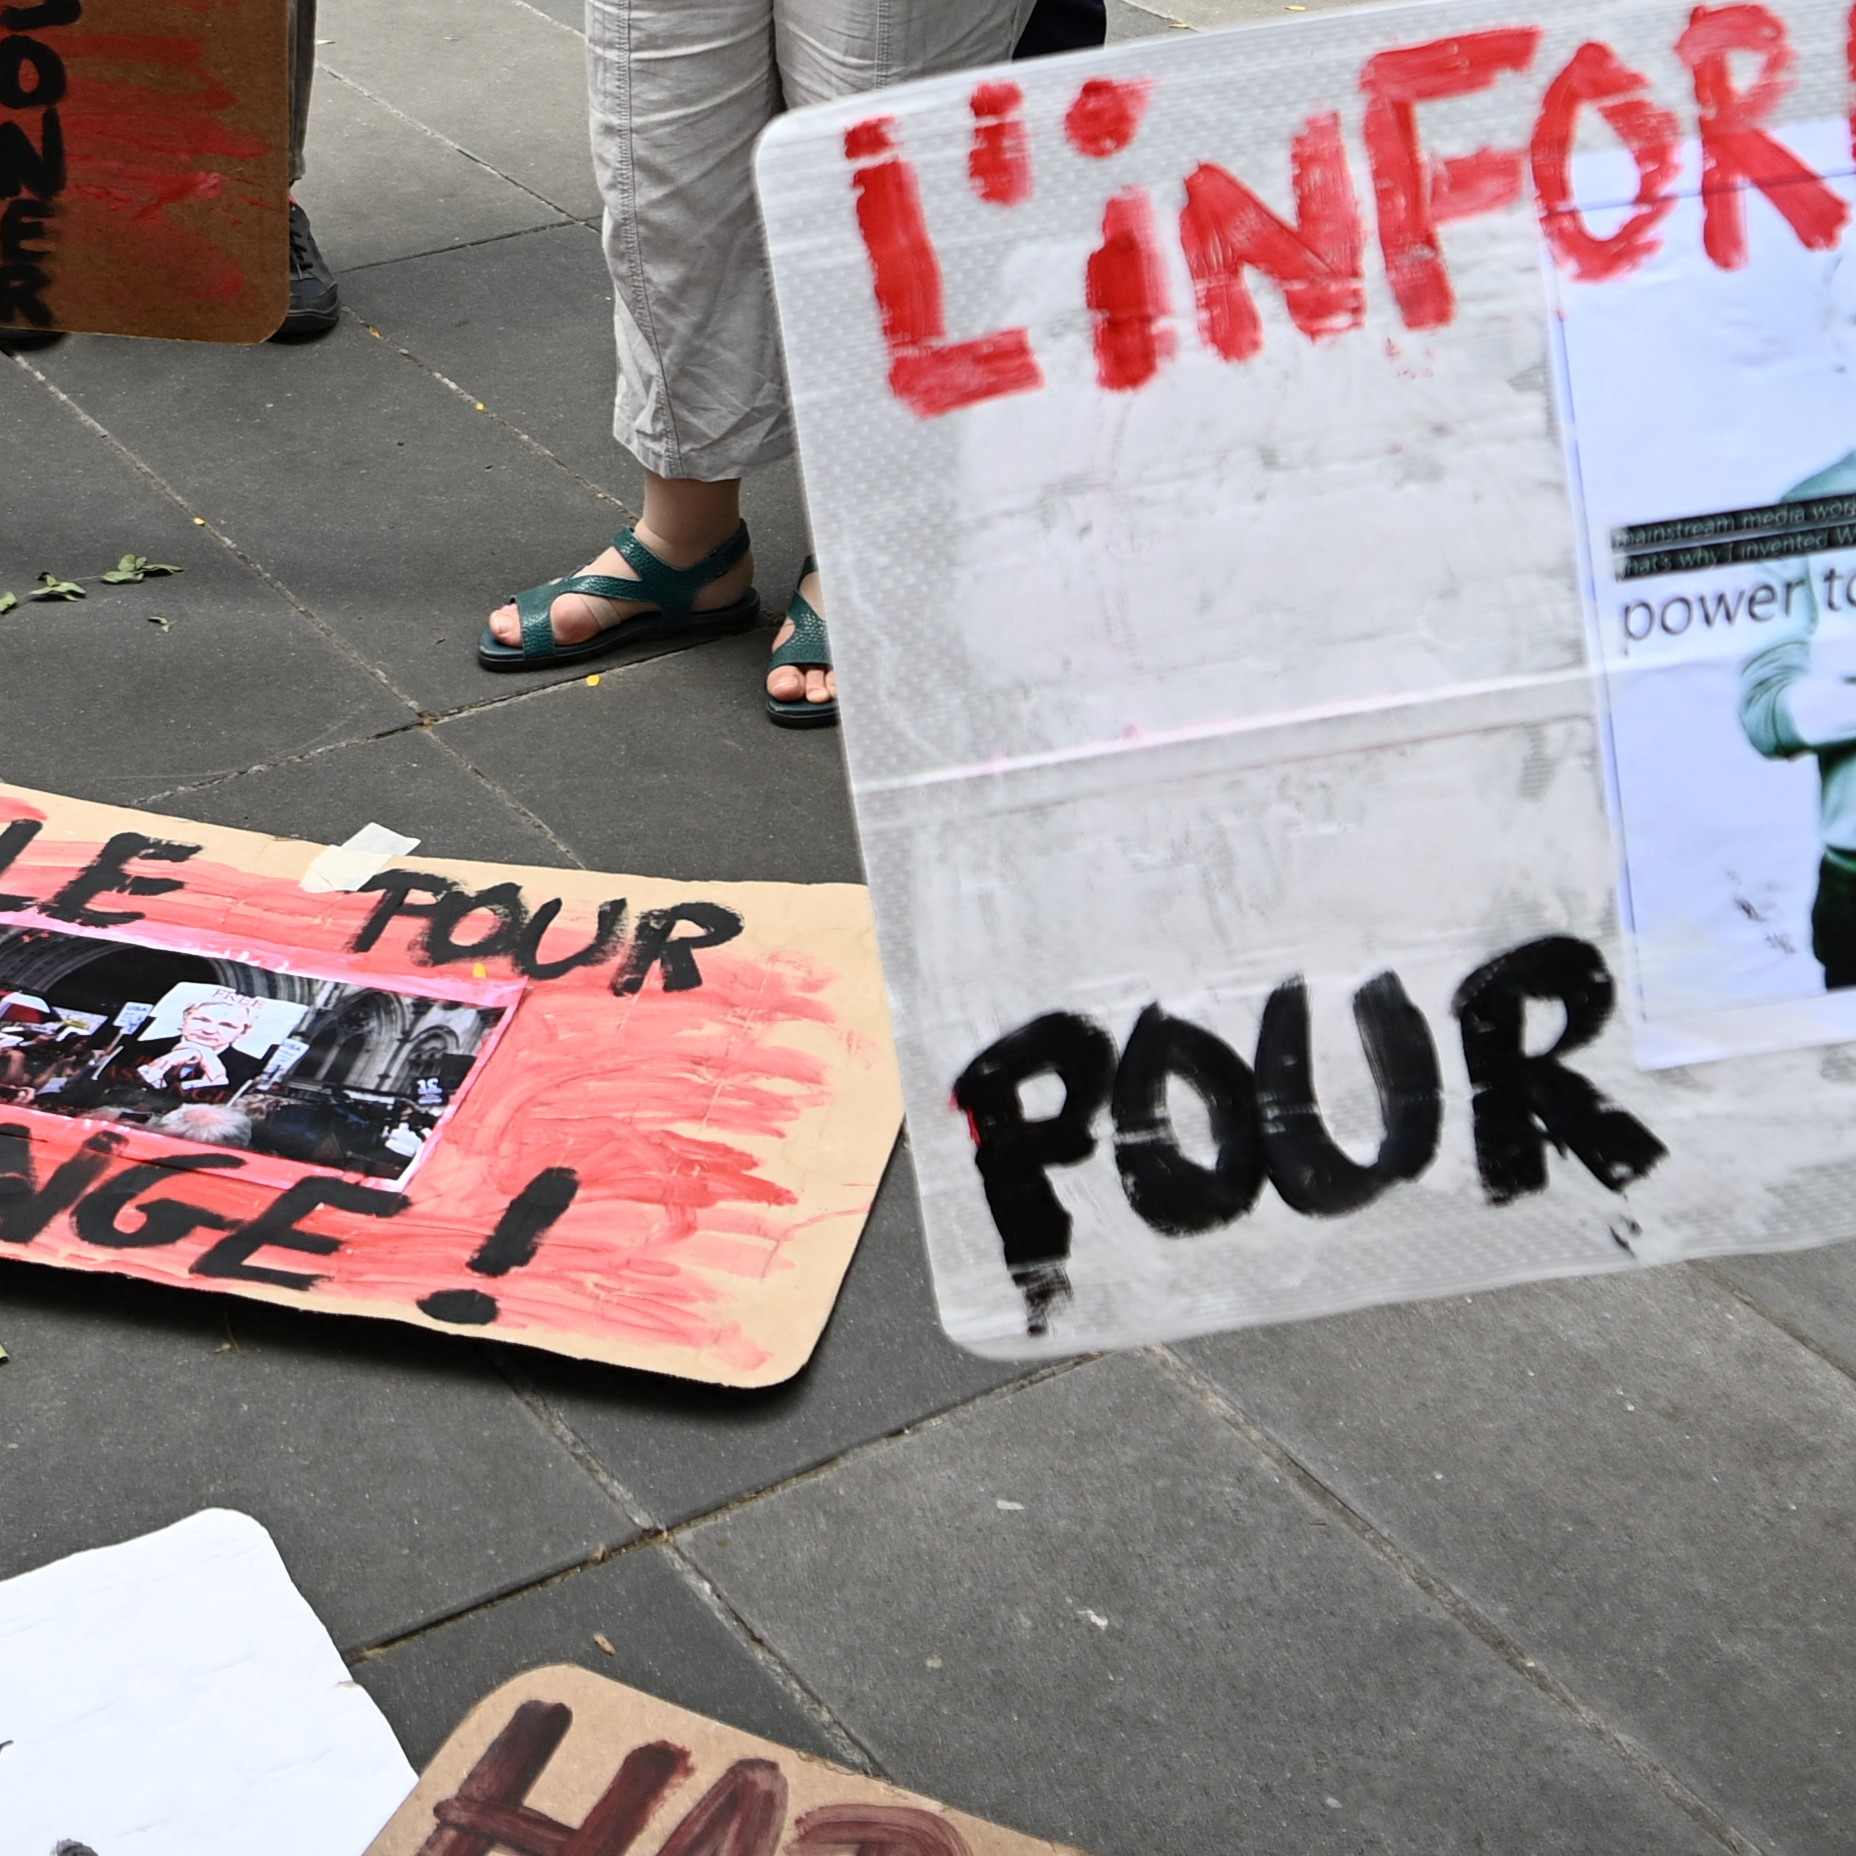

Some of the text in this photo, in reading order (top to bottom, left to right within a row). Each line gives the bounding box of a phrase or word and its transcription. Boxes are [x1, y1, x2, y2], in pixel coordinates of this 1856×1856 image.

[1743, 505, 1805, 529] media
[1622, 576, 1806, 655] power
[349, 868, 744, 997] POUR
[950, 936, 1667, 1334] POUR
